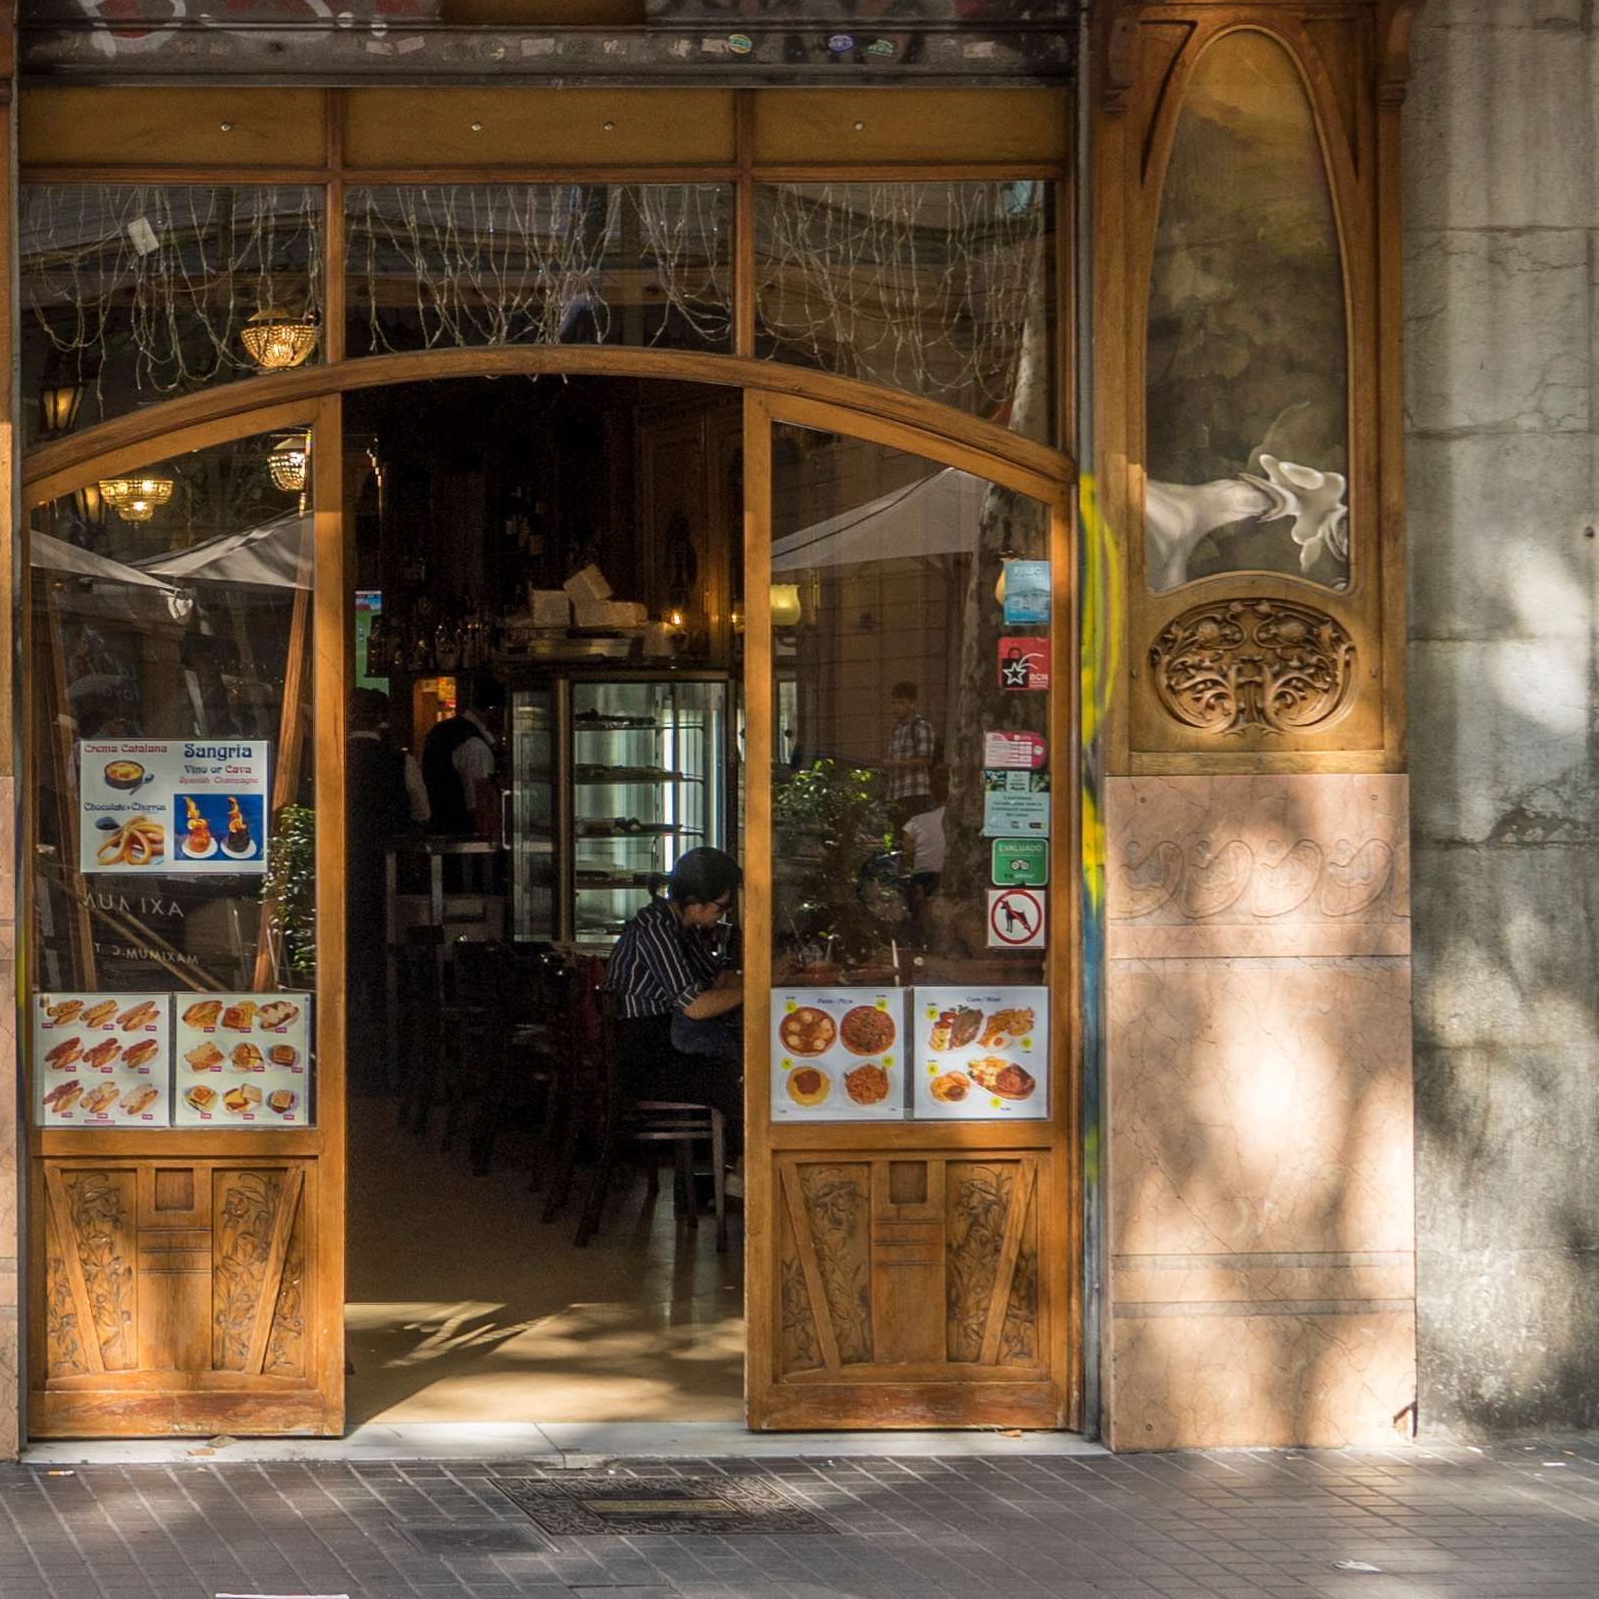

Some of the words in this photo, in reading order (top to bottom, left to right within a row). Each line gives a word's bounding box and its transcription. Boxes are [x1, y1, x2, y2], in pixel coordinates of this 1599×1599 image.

[84, 744, 118, 754] Crema
[121, 744, 167, 754] Catalana
[184, 743, 252, 762] Sangria
[226, 765, 252, 774] Cava
